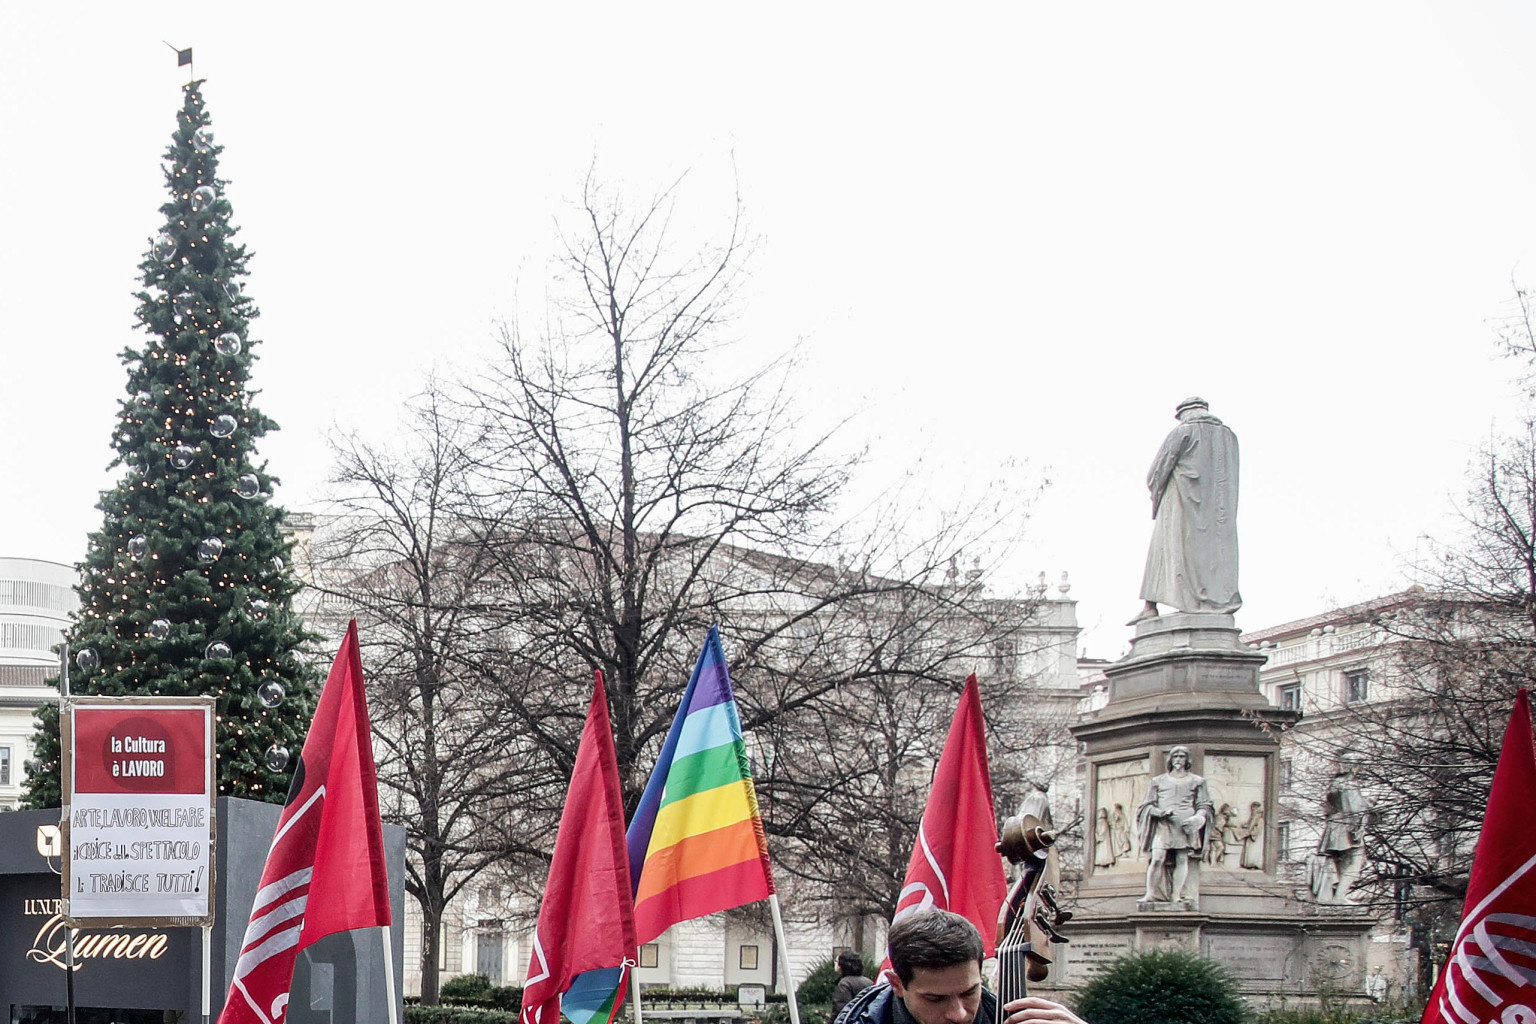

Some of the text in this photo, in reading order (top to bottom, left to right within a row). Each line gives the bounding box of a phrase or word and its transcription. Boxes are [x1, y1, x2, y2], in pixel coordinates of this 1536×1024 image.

[111, 736, 166, 753] la Cultura
[112, 760, 164, 777] è LAVORO
[130, 841, 201, 860] SPETTACOLO
[24, 899, 63, 915] LUXUR
